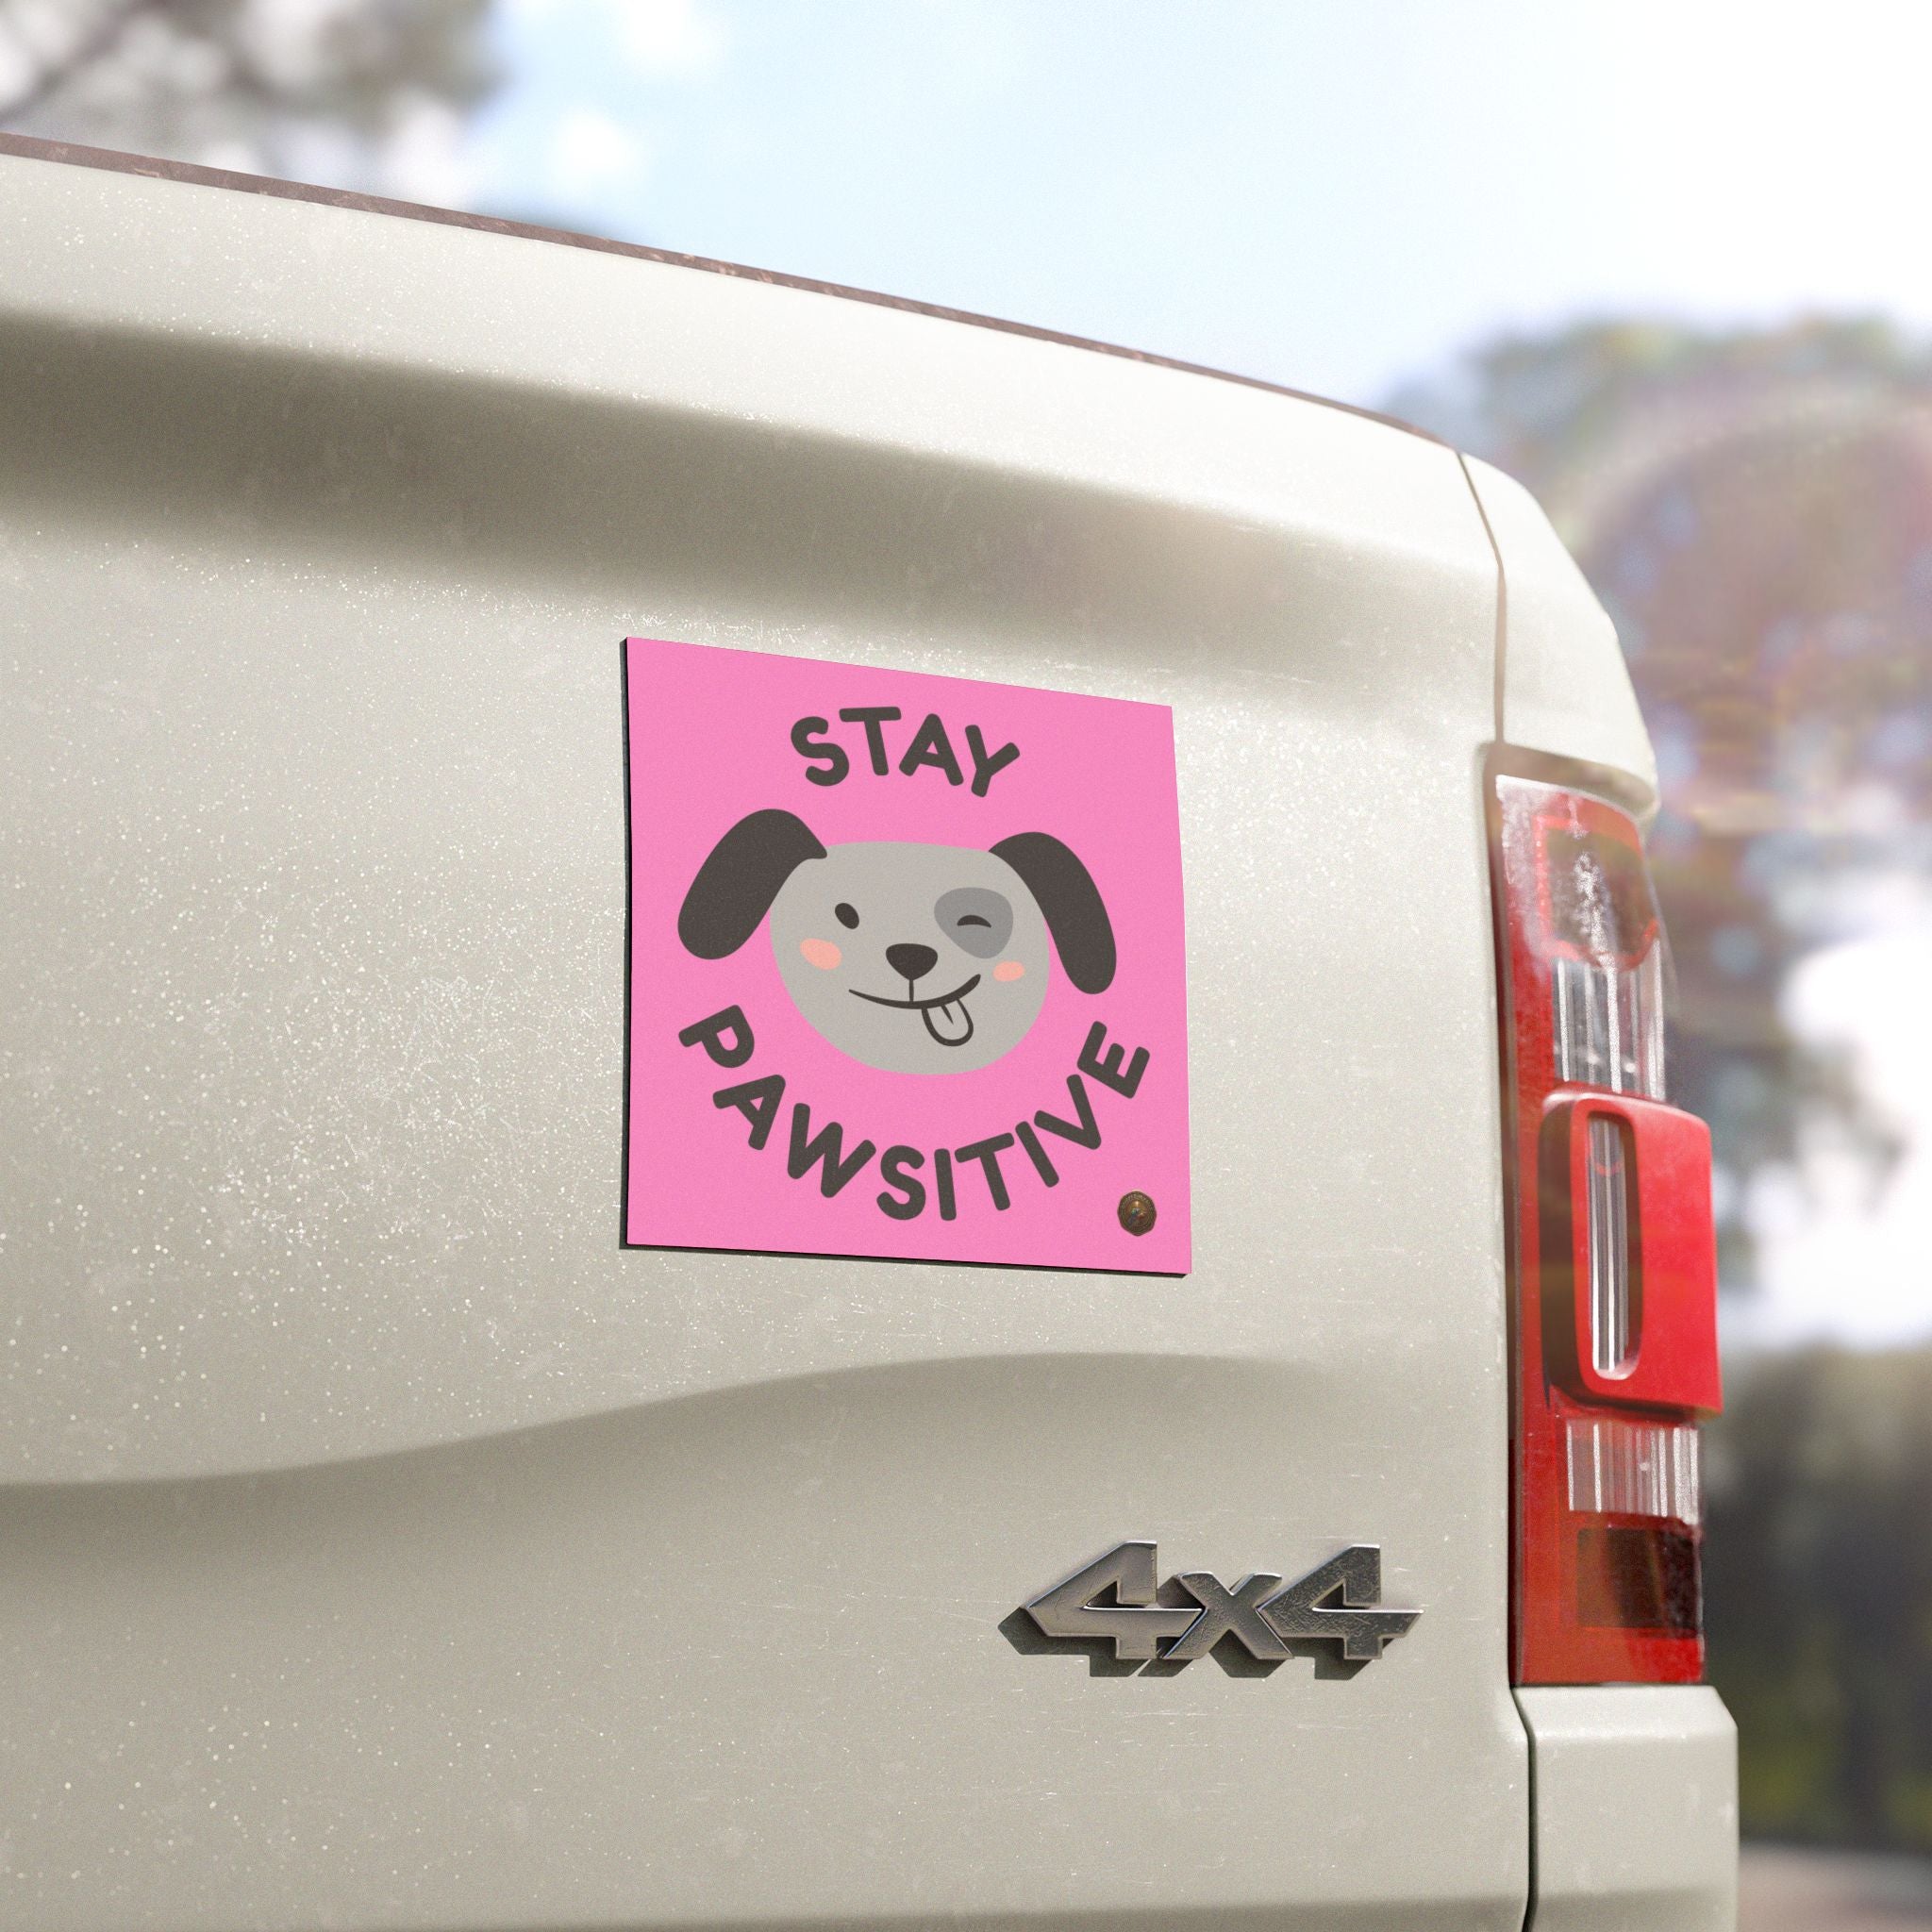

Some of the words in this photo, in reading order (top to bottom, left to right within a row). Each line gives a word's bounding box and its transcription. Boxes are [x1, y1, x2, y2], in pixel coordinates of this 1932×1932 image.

[791, 706, 1021, 798] STAY
[678, 1005, 1151, 1222] PAWSITIVE
[1024, 1540, 1424, 1660] 4x4
